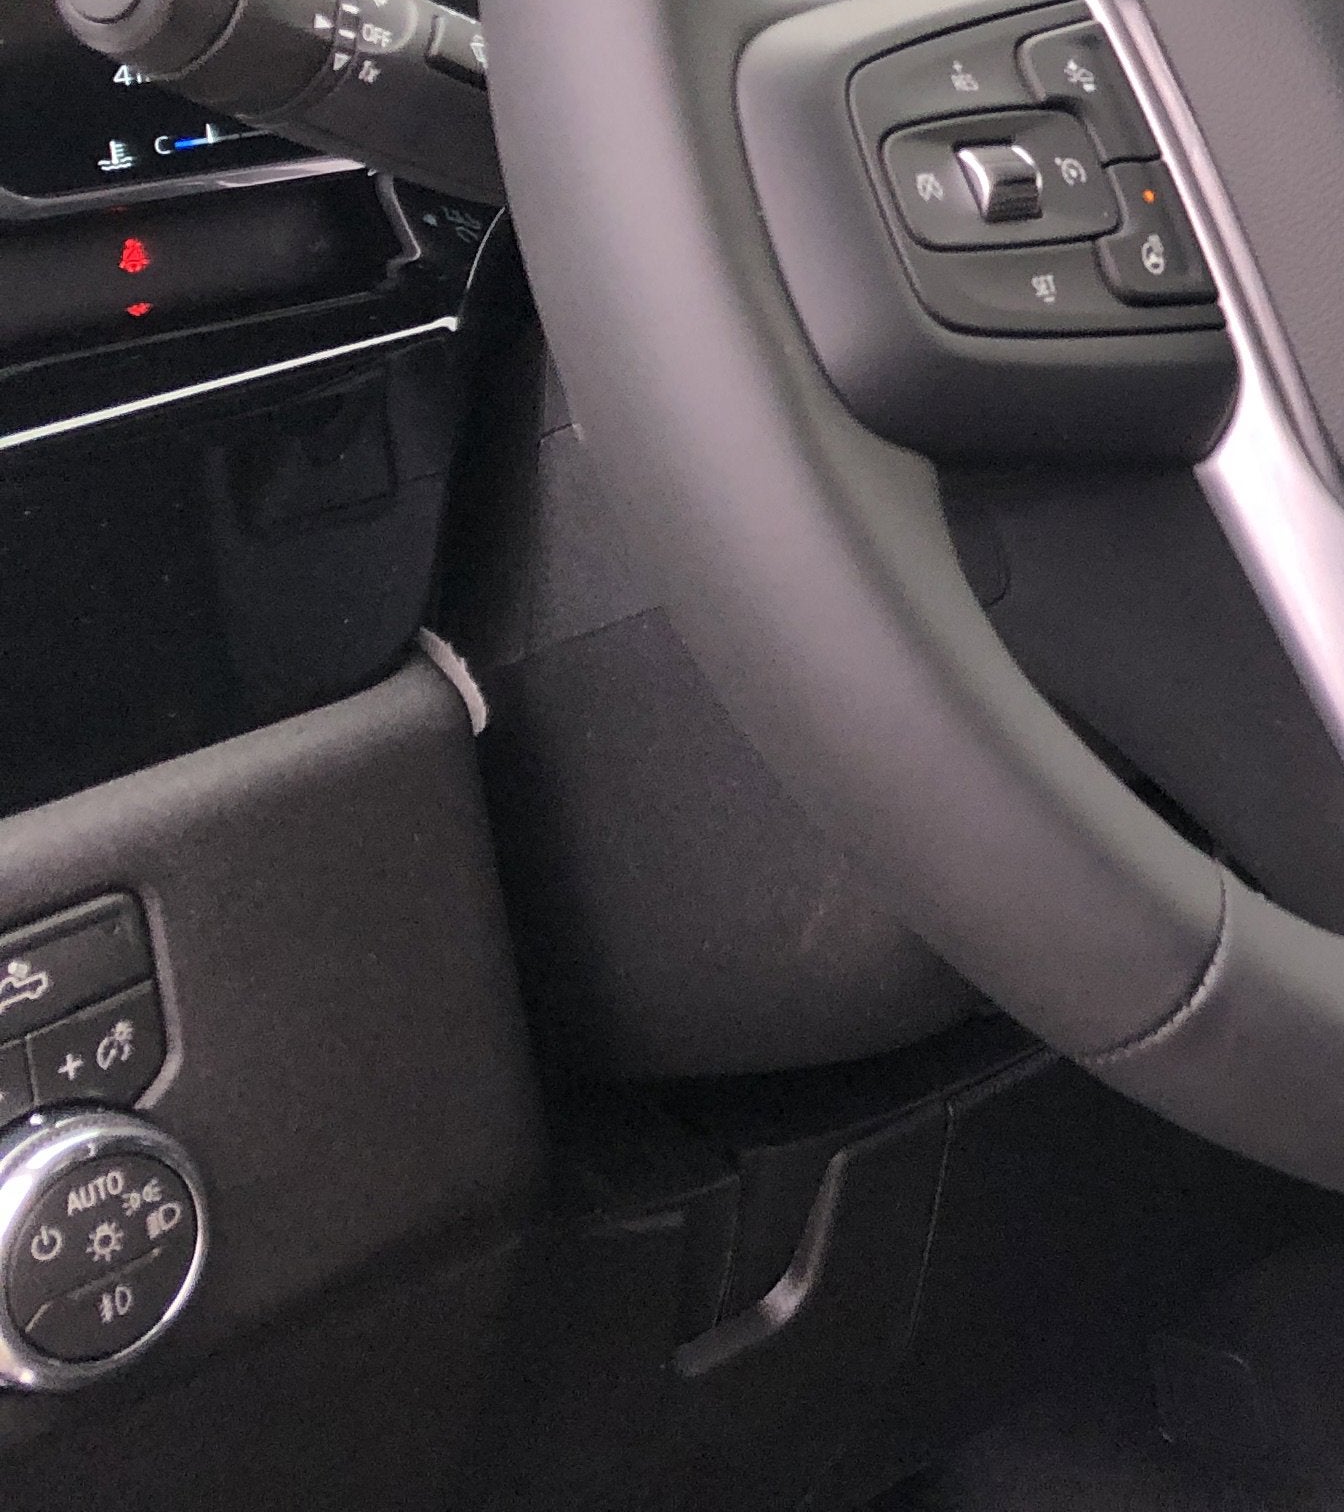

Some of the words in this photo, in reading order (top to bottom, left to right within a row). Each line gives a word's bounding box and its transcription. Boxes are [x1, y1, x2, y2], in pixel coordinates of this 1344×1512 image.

[362, 23, 393, 48] OFF
[155, 135, 173, 155] C
[67, 1169, 126, 1216] AUTO
